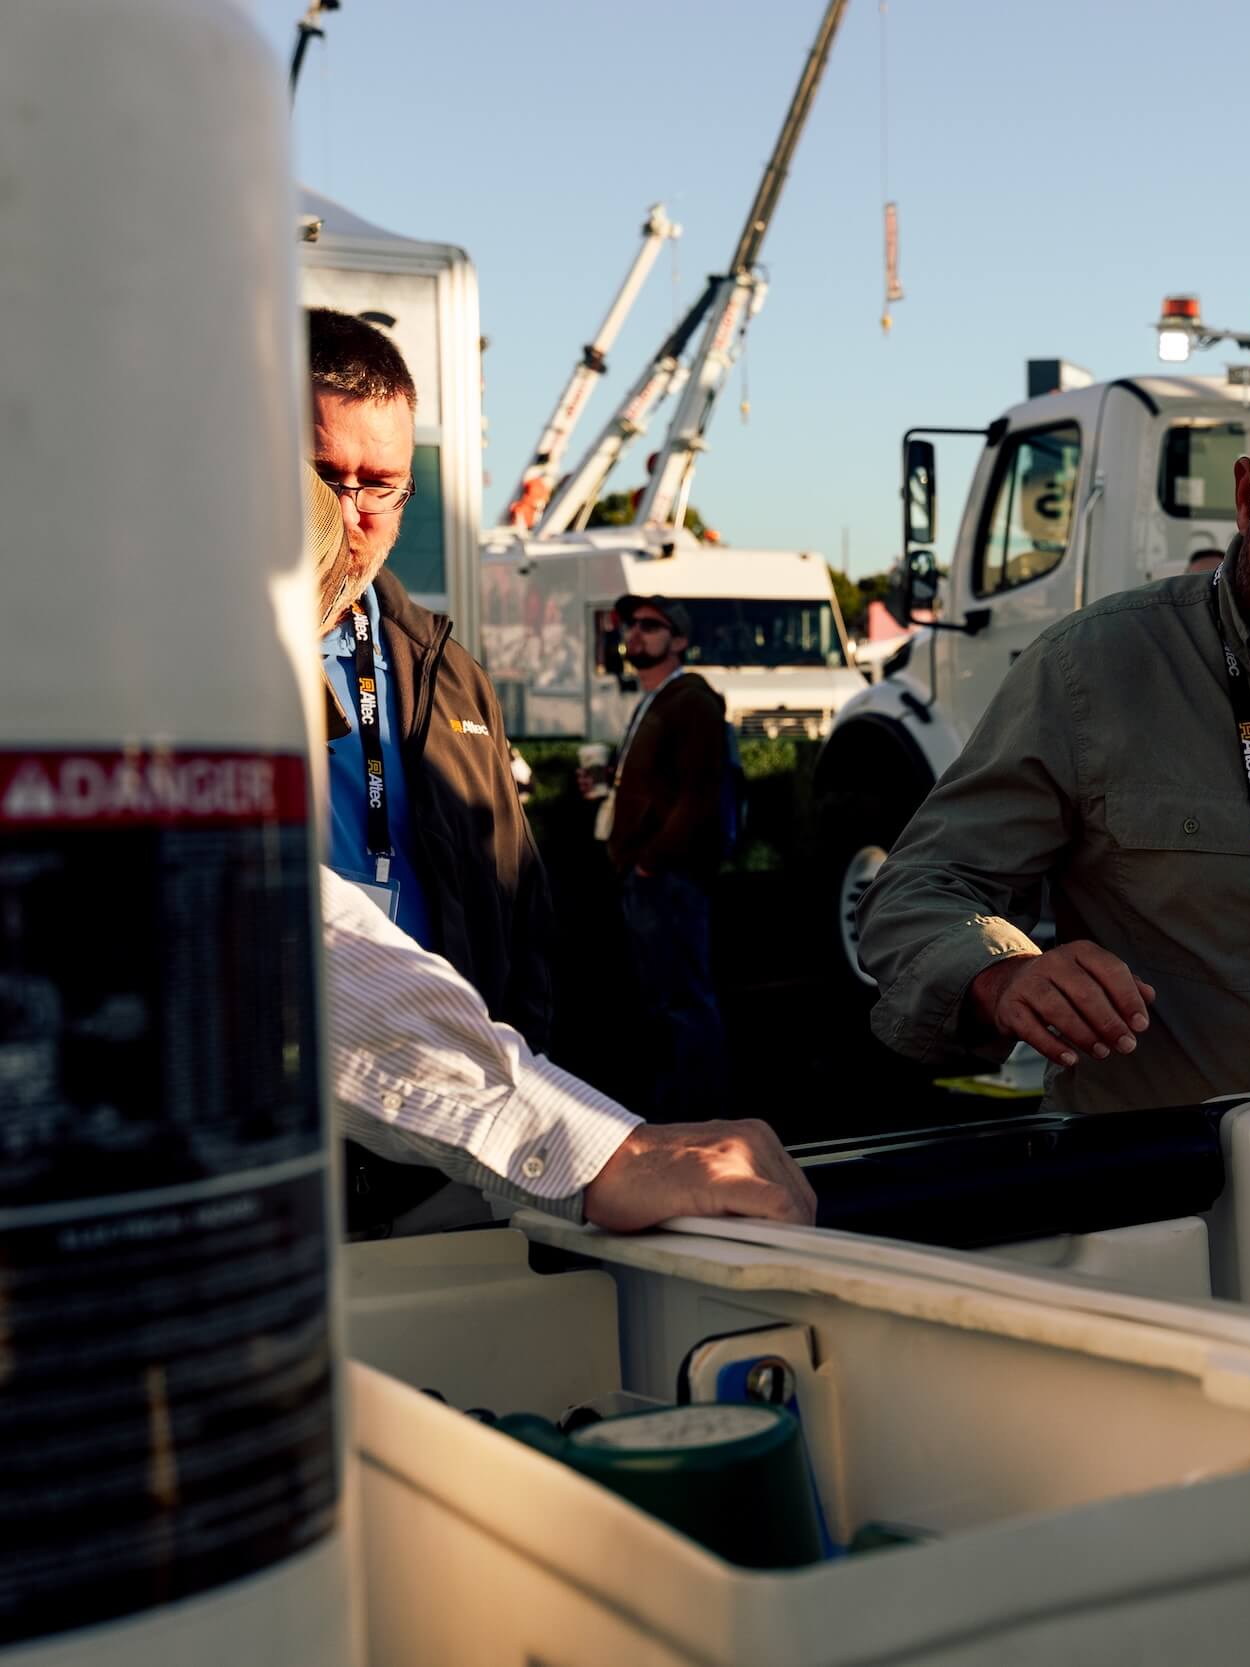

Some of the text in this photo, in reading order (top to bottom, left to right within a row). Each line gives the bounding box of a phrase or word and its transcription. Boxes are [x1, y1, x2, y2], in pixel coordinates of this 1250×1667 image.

[352, 610, 370, 642] Altec
[359, 690, 377, 725] Altec
[462, 720, 489, 736] Altec
[58, 759, 275, 816] DANGER
[368, 773, 384, 809] Altec
